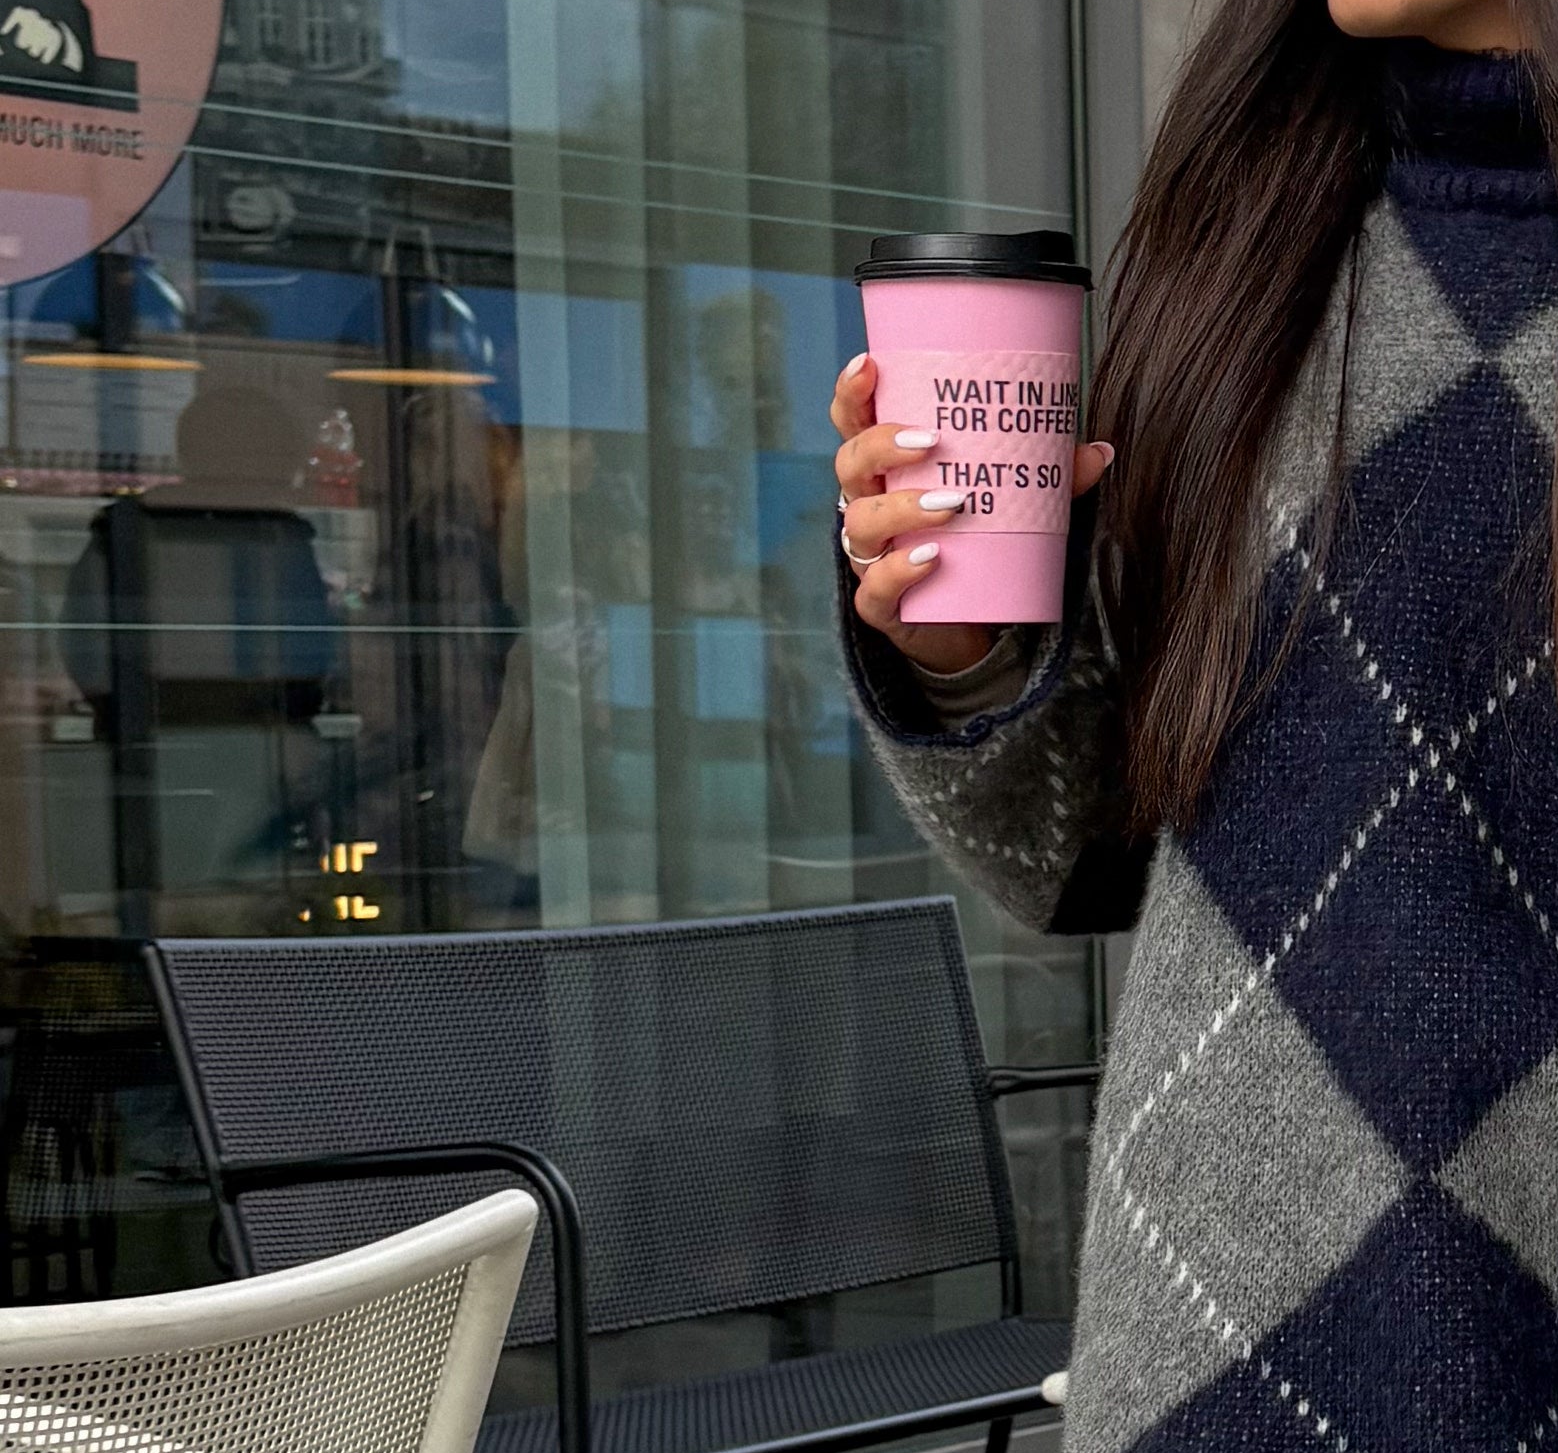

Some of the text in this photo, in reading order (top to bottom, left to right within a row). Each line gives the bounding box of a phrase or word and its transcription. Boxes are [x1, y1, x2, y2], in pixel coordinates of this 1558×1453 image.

[71, 122, 144, 160] MORE
[933, 378, 1011, 404] WAIT
[1018, 381, 1044, 406] IN
[936, 406, 987, 432] FOR
[937, 462, 1062, 489] THAT'S SO
